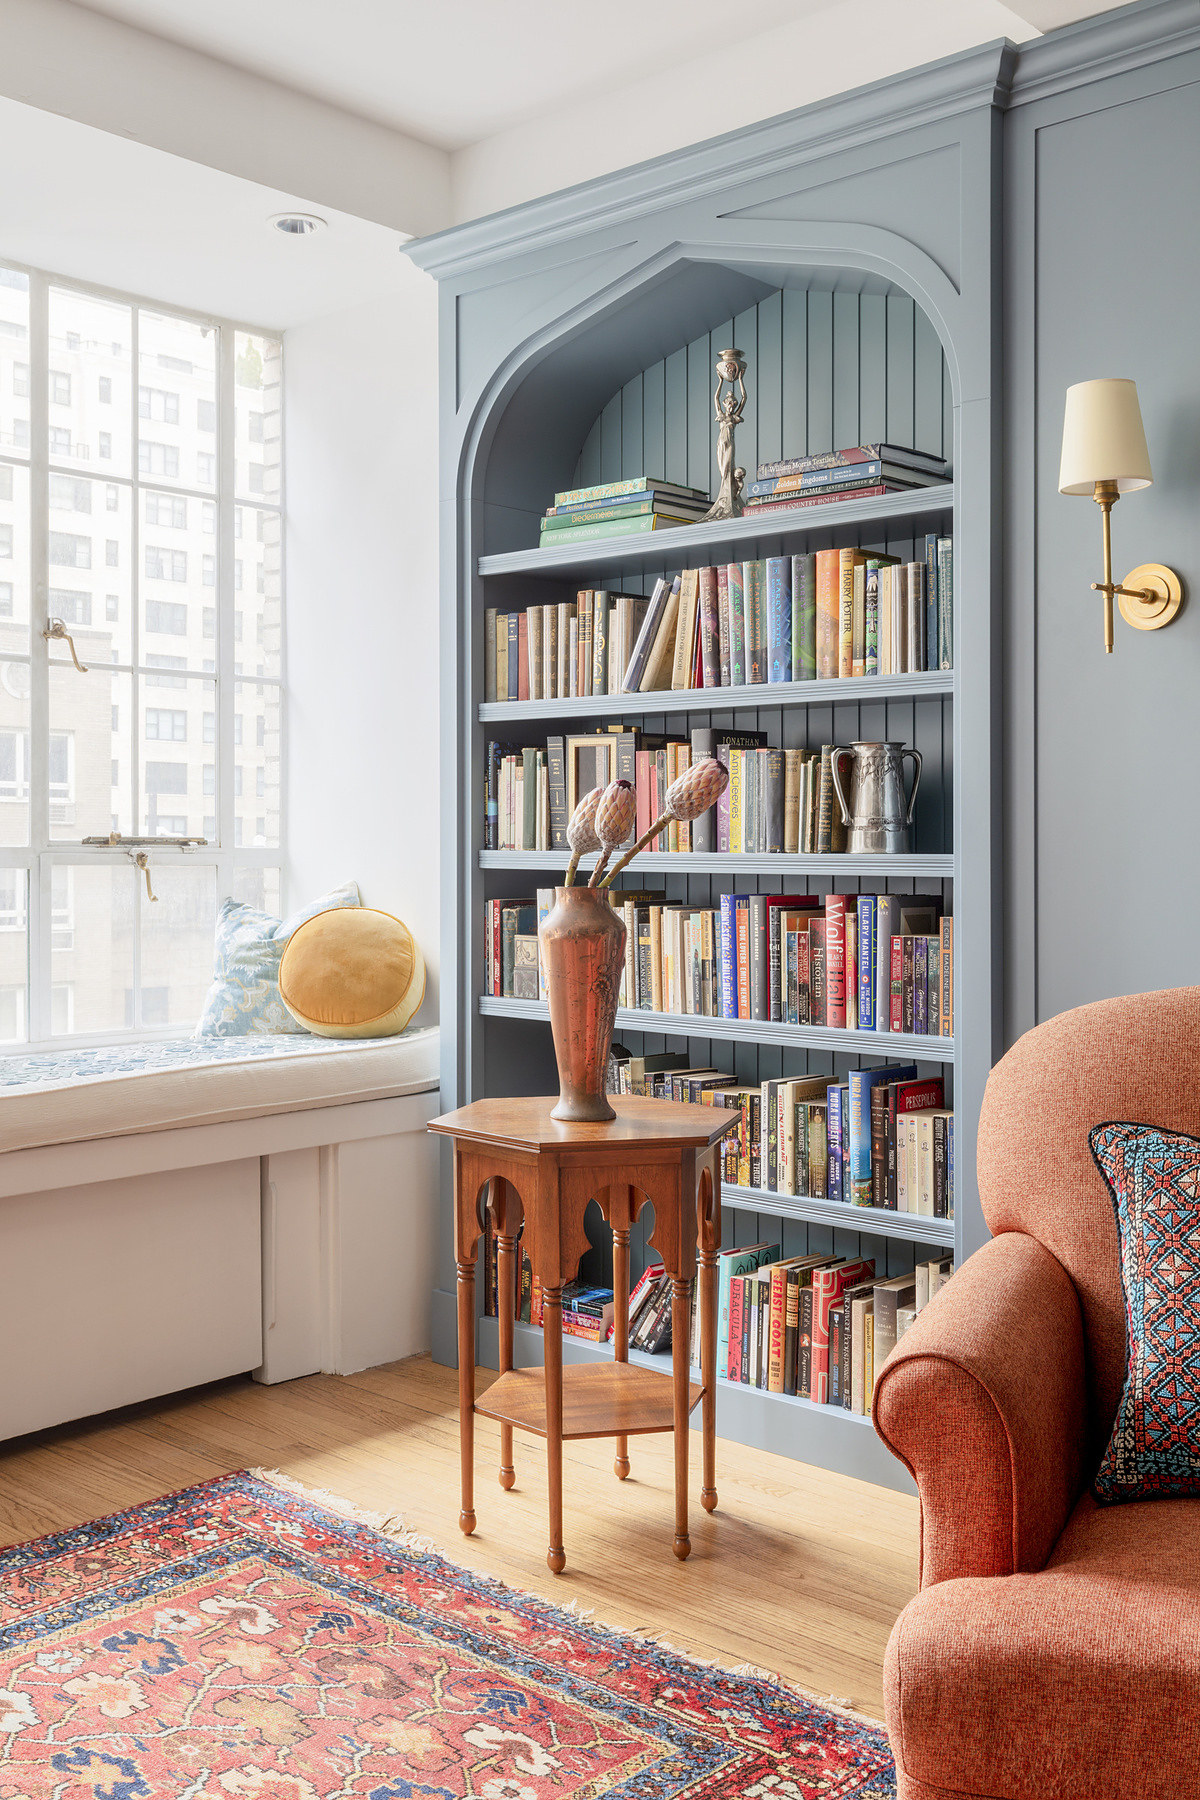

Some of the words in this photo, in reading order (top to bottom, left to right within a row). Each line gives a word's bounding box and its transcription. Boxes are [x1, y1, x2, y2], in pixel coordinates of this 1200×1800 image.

[769, 464, 791, 473] William
[793, 460, 811, 469] Morris
[812, 455, 837, 466] Textiles
[776, 478, 797, 489] Golden
[798, 474, 828, 487] Kingdoms
[765, 494, 778, 502] THE
[779, 490, 797, 500] IRISH
[799, 486, 822, 497] HOME
[566, 504, 583, 512] Perfect
[583, 501, 602, 511] English
[746, 507, 758, 517] THE
[759, 503, 787, 515] ENGLISH
[787, 499, 816, 511] COUNTRY
[816, 495, 840, 506] HOUSE
[559, 532, 573, 541] YORK
[927, 543, 935, 572] European
[843, 569, 852, 599] HARRY
[842, 600, 852, 633] POTTER
[679, 641, 685, 651] OF
[722, 736, 760, 747] JONATHAN
[731, 753, 740, 775] Ann
[731, 776, 740, 819] Cleeves
[721, 902, 730, 928] FUNNY
[826, 901, 844, 954] Wolf
[721, 928, 730, 951] STORY
[861, 938, 869, 971] MANTEL
[722, 959, 730, 979] EMILY
[739, 967, 747, 987] EMILY
[803, 972, 808, 980] OF
[813, 947, 824, 998] Historian
[722, 982, 730, 1004] HENRY
[828, 970, 844, 1007] Hall
[852, 1076, 862, 1098] NORA
[830, 1092, 838, 1113] NORA
[905, 1092, 937, 1110] PERSEPOLIS
[852, 1100, 862, 1136] ROBERTS
[934, 1118, 944, 1140] DOROTHY
[830, 1115, 839, 1149] ROBERTS
[852, 1138, 861, 1175] HIDEAWAY
[935, 1145, 944, 1163] SAYERS
[753, 1162, 761, 1184] THUD!
[772, 1279, 783, 1313] FEAST
[731, 1283, 741, 1340] DRACULA
[772, 1319, 781, 1358] GOAT
[801, 1350, 810, 1385] Fingersmith
